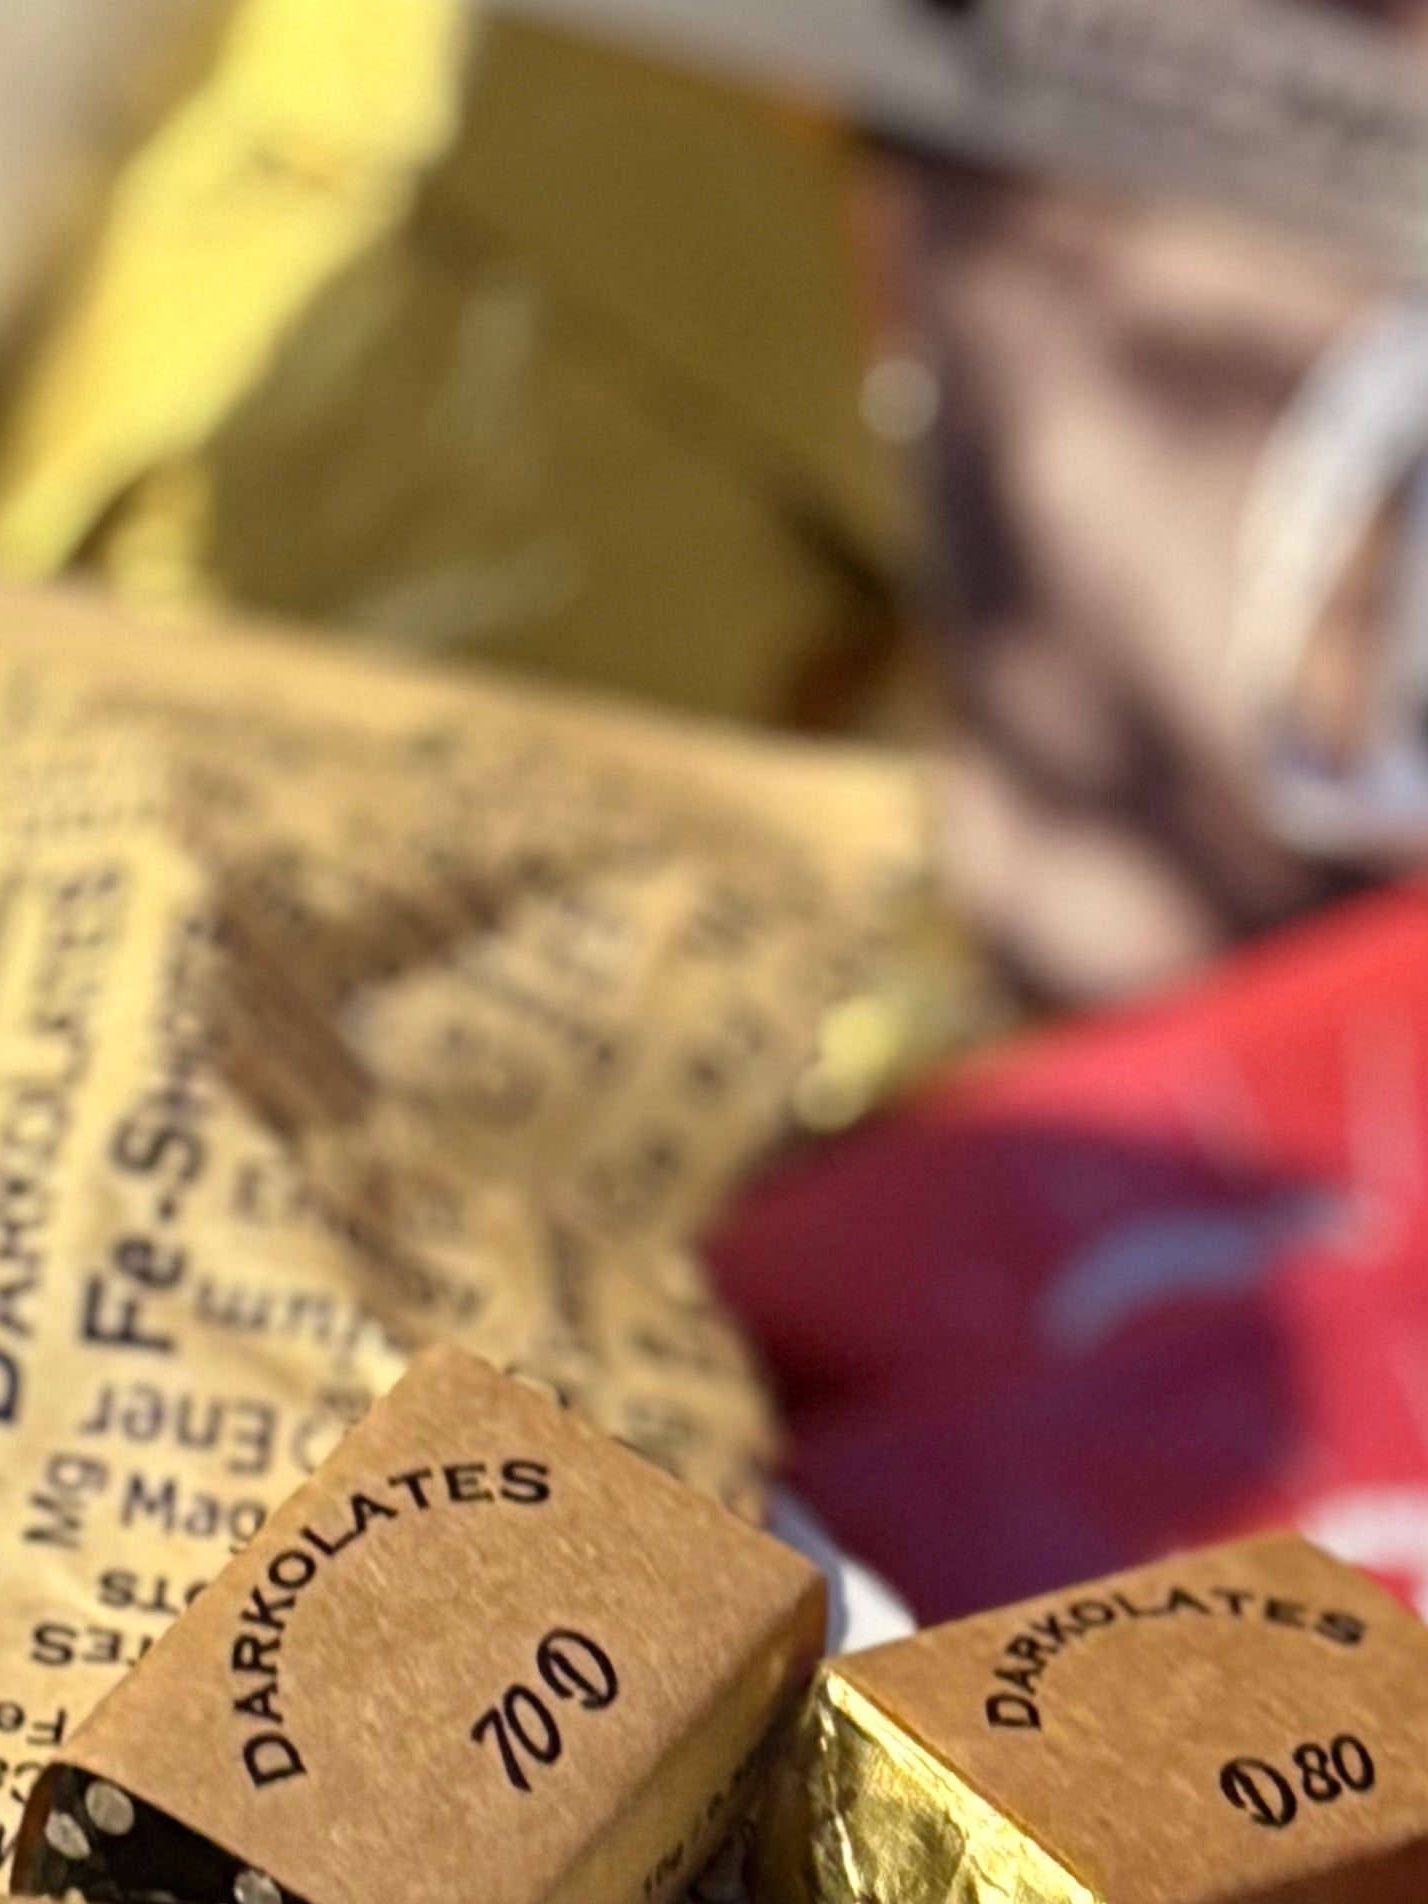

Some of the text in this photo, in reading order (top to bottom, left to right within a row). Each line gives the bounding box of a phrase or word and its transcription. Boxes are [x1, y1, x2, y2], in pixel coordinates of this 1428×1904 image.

[22, 1452, 110, 1549] Mg
[230, 1458, 552, 1789] DARKOLATES
[985, 1587, 1367, 1733] DARKOLATES
